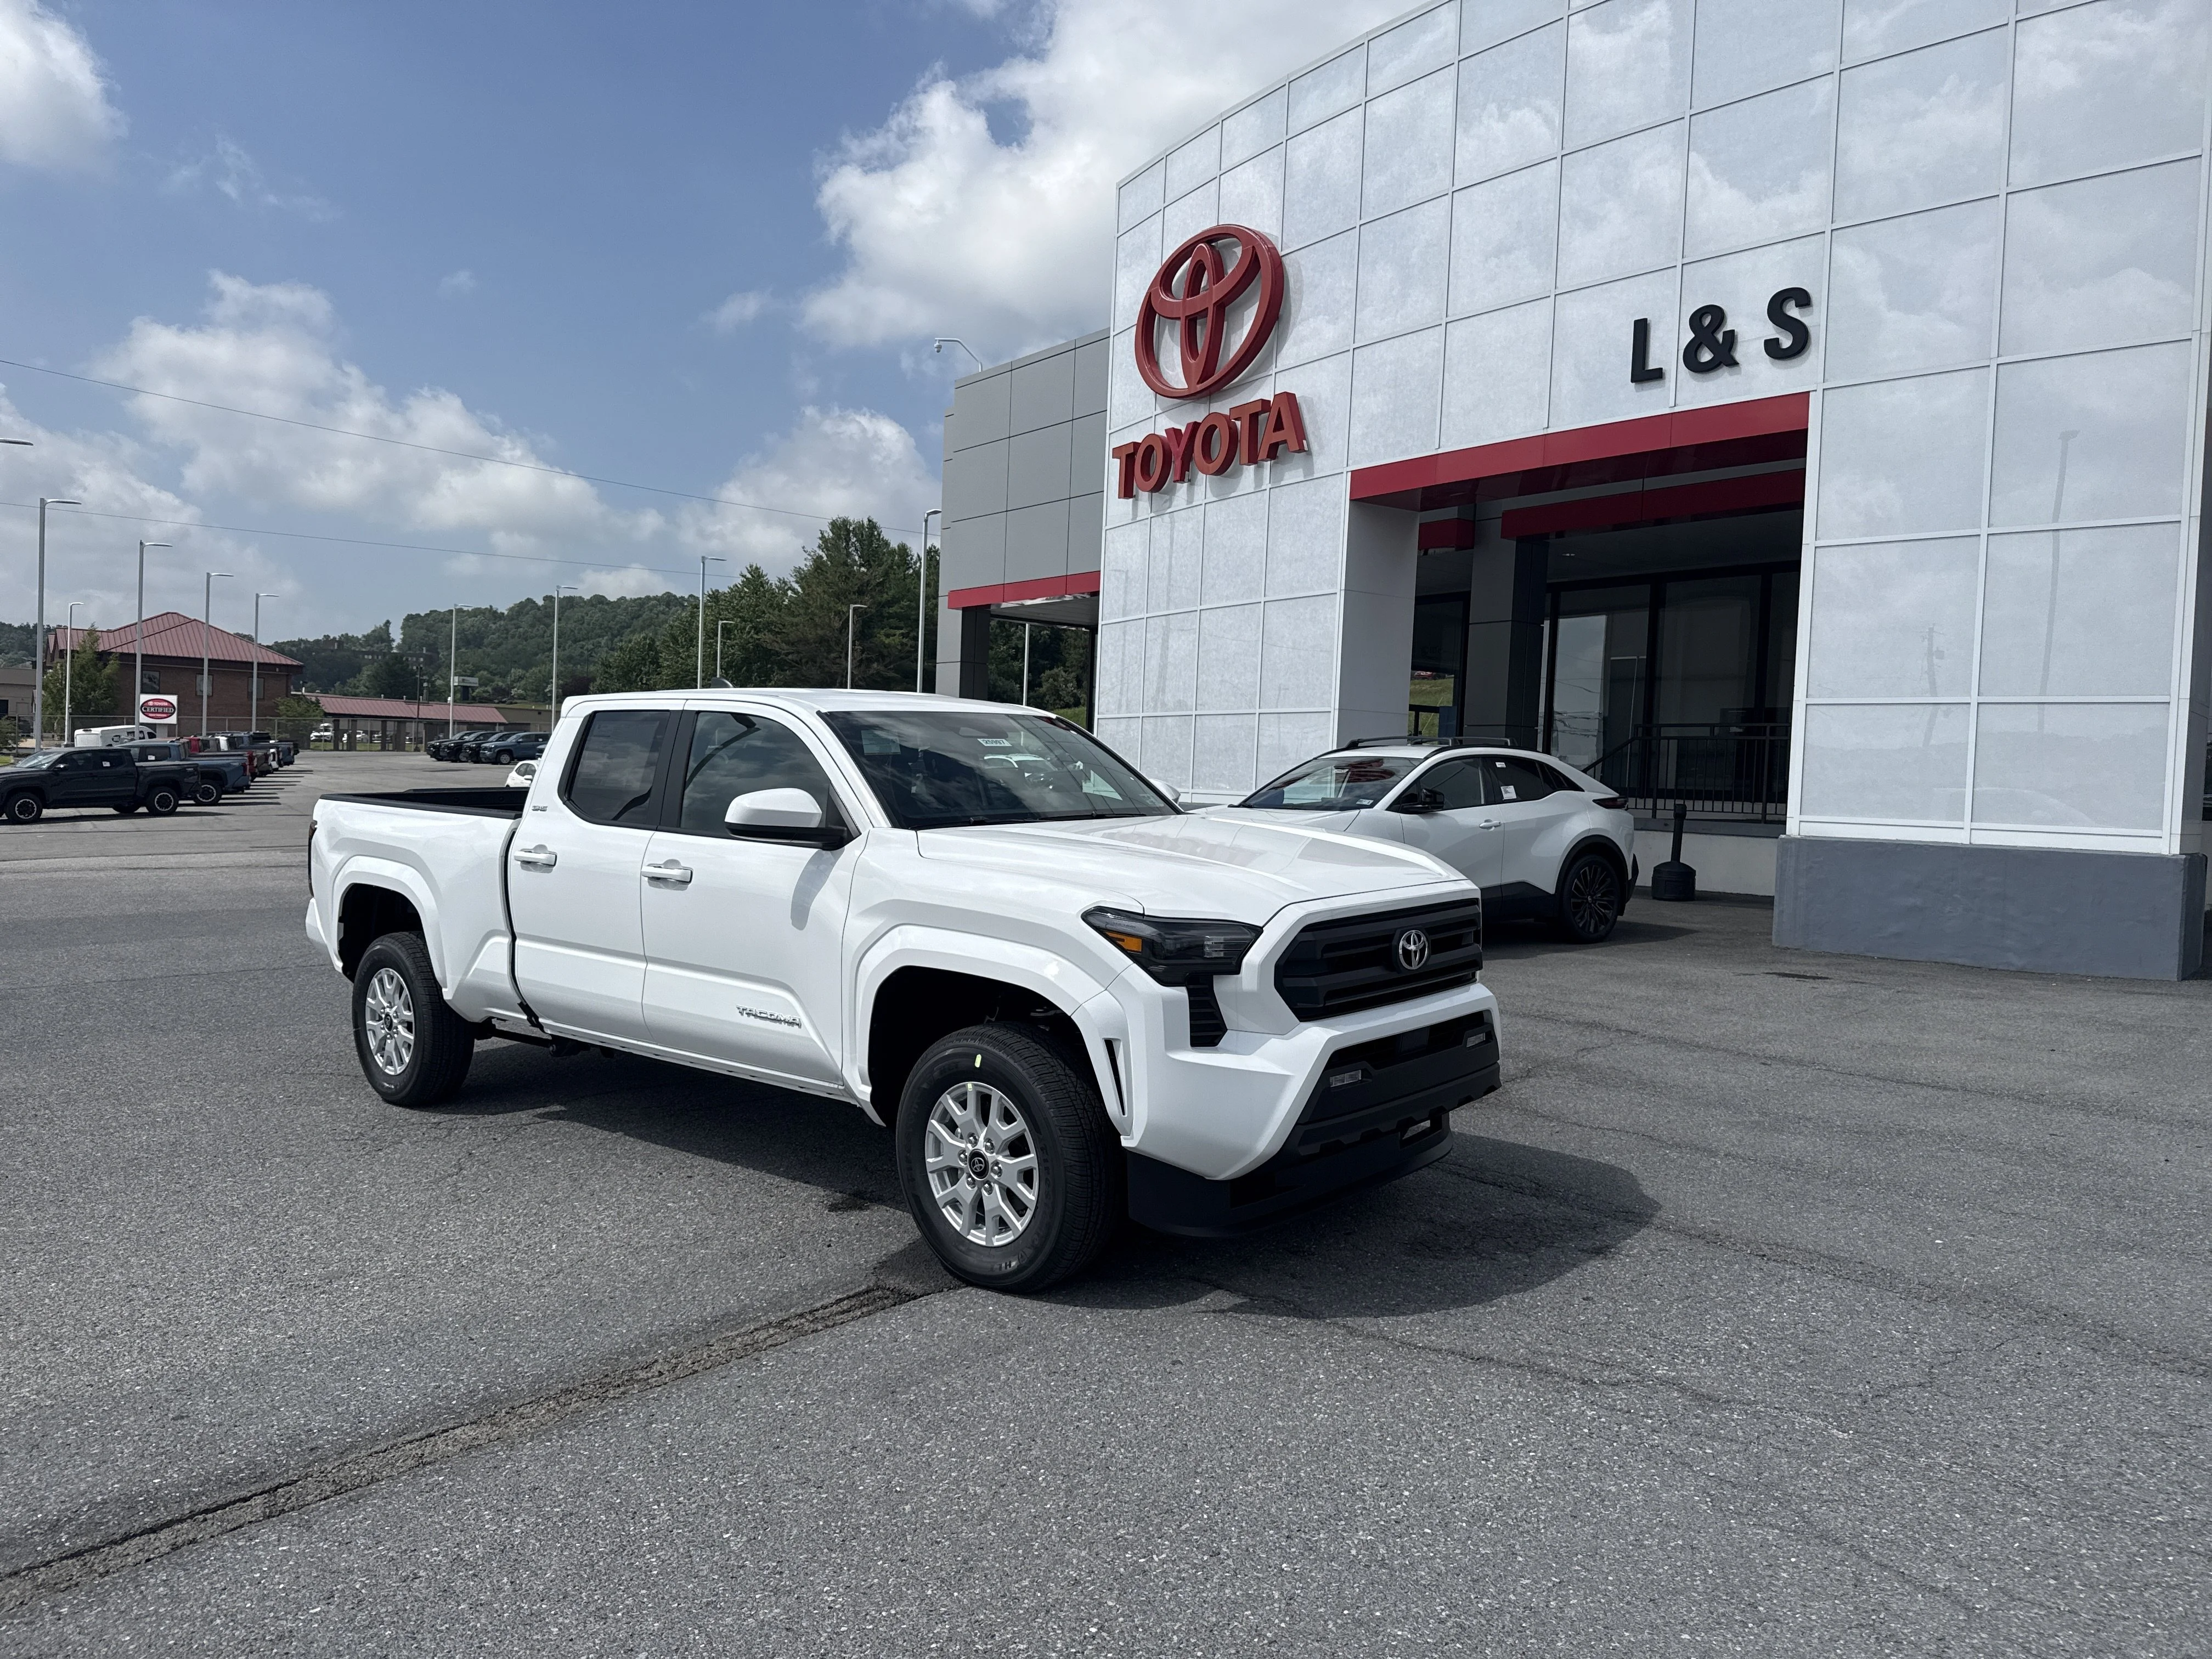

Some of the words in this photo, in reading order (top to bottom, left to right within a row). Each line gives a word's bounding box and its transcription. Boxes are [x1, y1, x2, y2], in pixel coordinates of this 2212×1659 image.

[1630, 318, 1663, 383] L
[1683, 304, 1739, 373] &
[1764, 287, 1811, 360] S
[1112, 391, 1308, 500] TOYOTA
[736, 1005, 802, 1028] TACOMA
